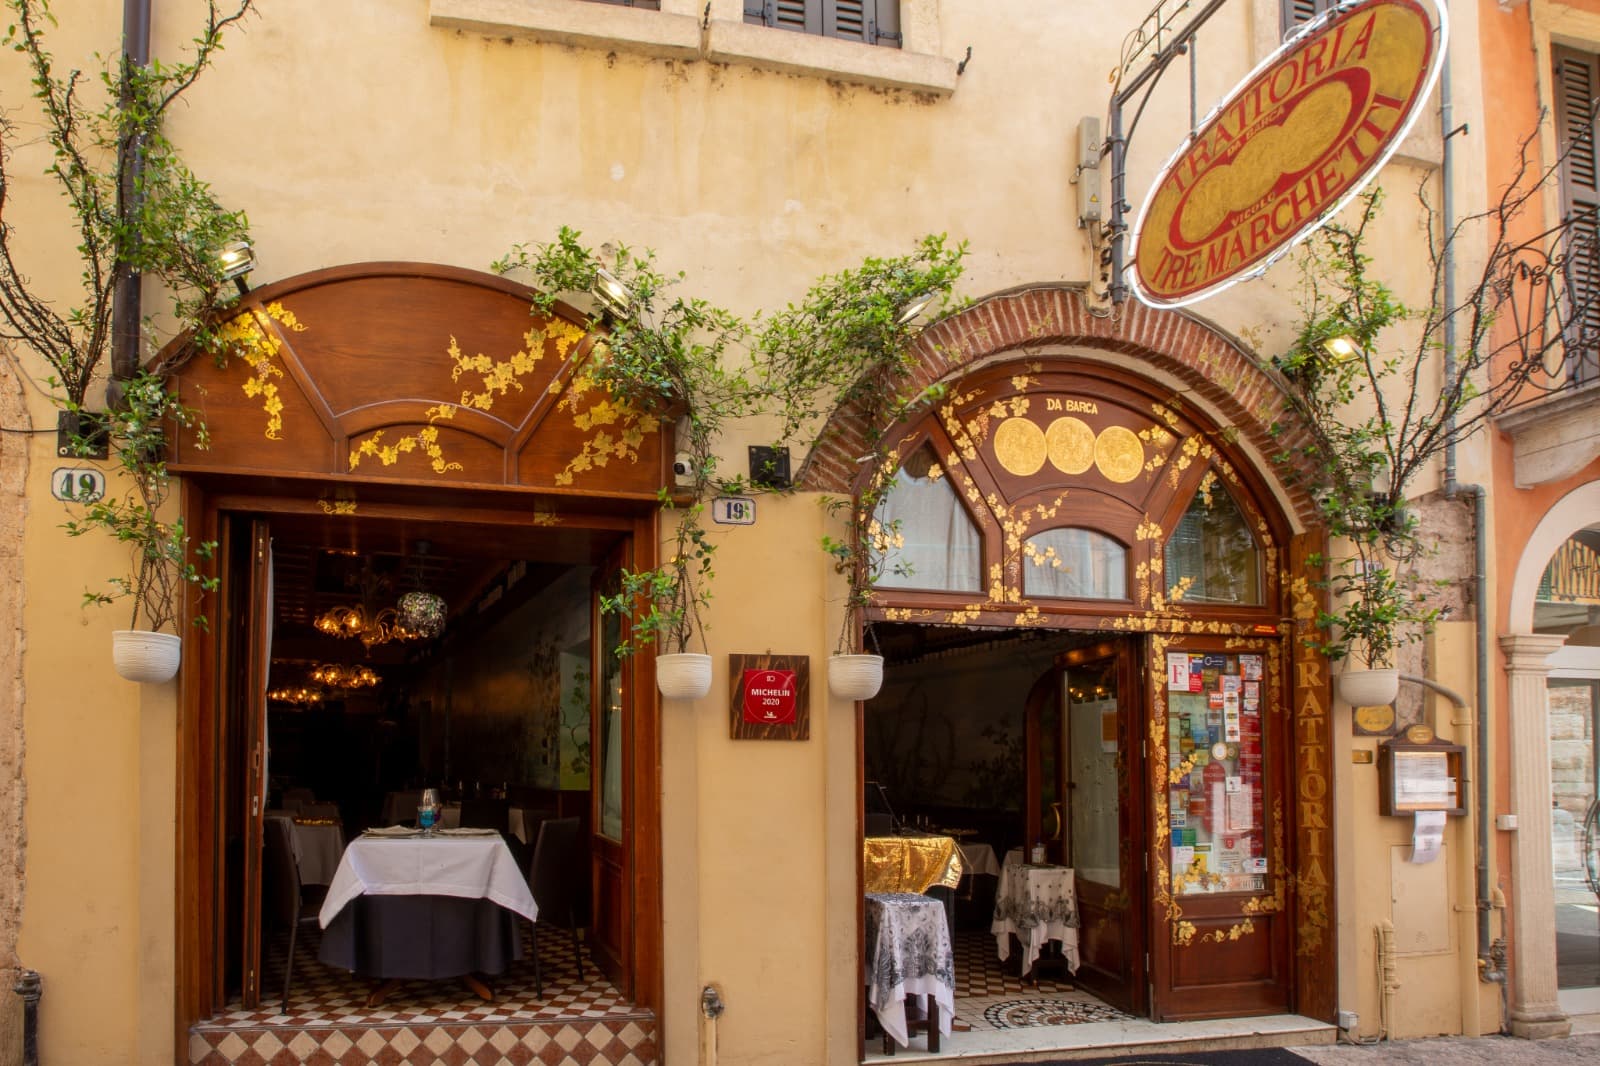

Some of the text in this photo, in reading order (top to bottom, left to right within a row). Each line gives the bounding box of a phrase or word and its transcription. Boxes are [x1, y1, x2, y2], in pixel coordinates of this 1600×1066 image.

[1165, 12, 1377, 194] TRATTORIA
[1152, 93, 1405, 289] TRE MARCHETTI
[1046, 398, 1098, 415] DA BARCA
[64, 473, 96, 497] 19
[726, 502, 744, 520] 19
[751, 688, 790, 697] MICHELIN
[762, 697, 780, 706] 2020
[1295, 632, 1329, 887] TRATTORIA
